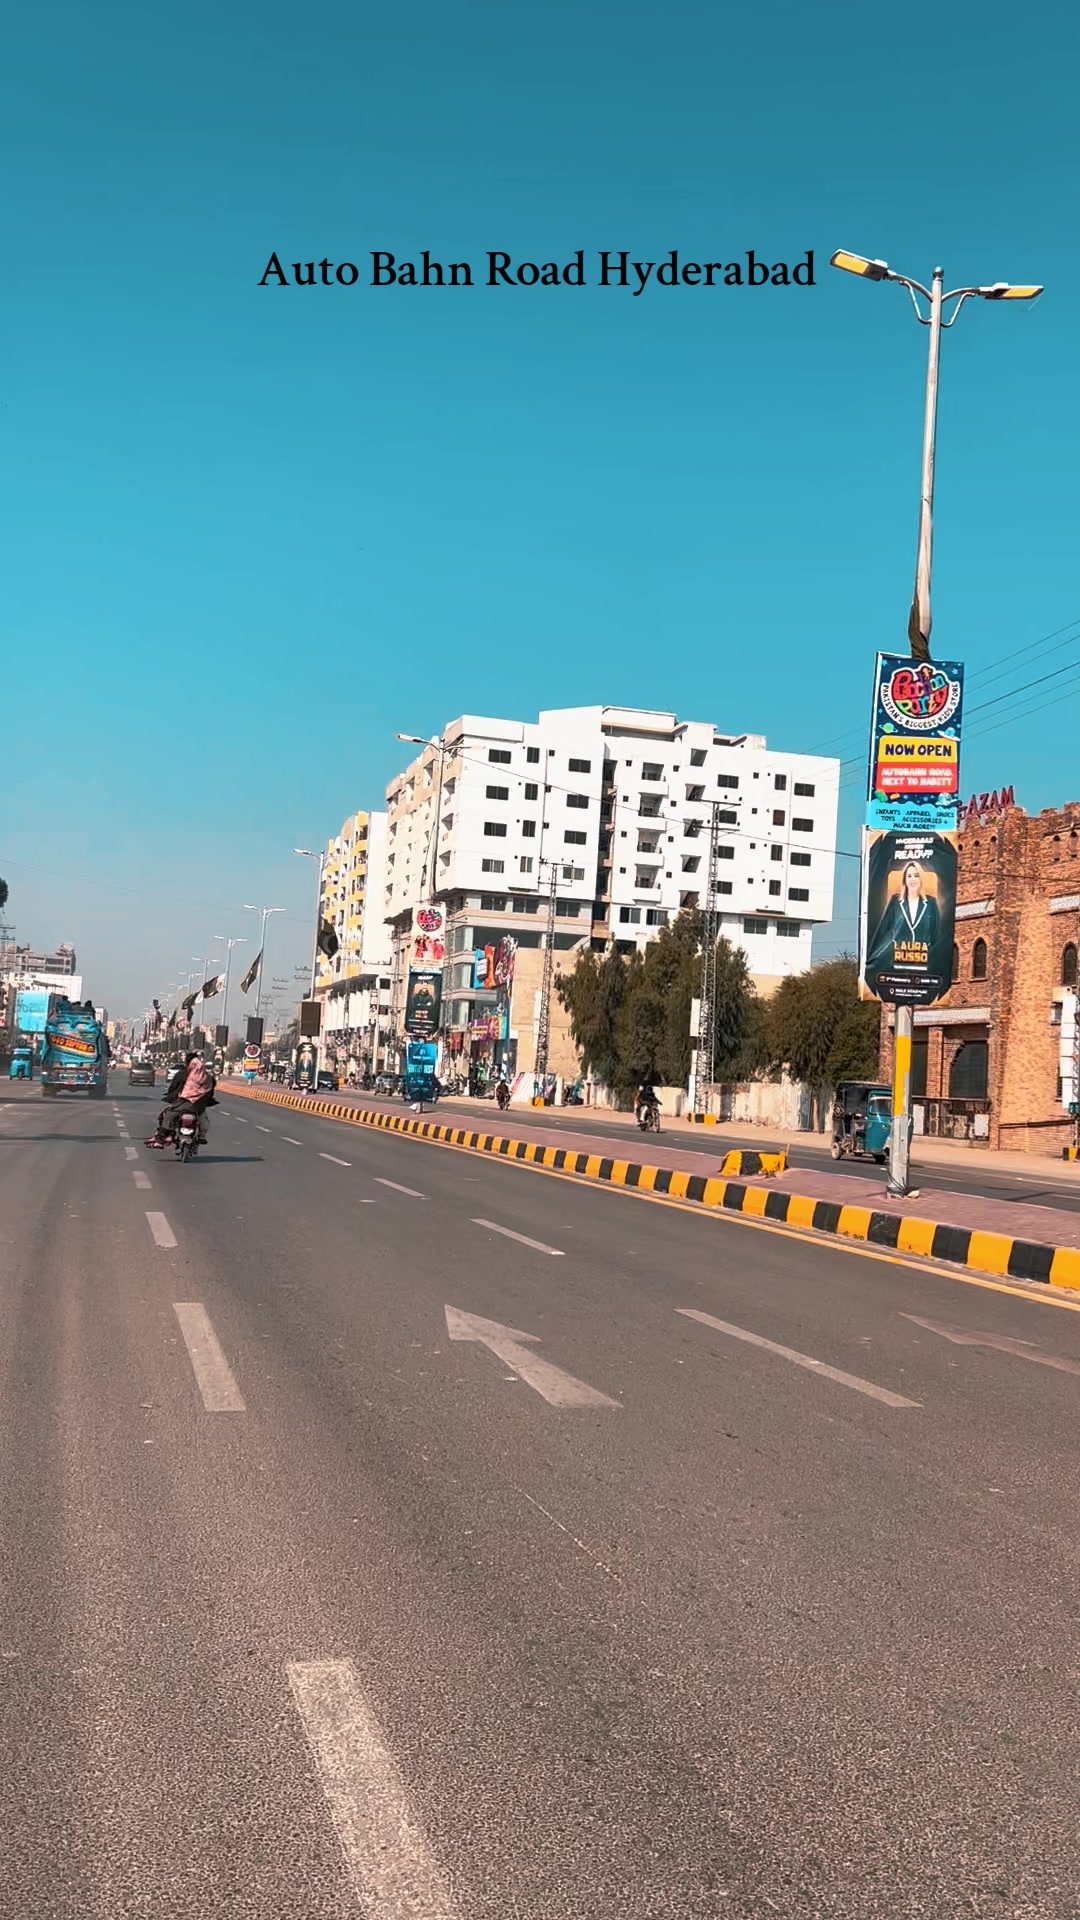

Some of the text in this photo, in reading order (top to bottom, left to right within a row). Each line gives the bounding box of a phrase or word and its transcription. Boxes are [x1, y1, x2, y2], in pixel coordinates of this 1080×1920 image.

[904, 719, 937, 729] BIGGEST
[937, 708, 954, 723] KIDS
[950, 683, 960, 707] STORE
[885, 743, 952, 757] NOW OPEN
[881, 777, 906, 786] NEXT
[907, 777, 919, 786] TO
[958, 785, 1015, 821] AZAM
[880, 815, 896, 823] TOYS
[894, 849, 934, 860] READY?
[893, 941, 929, 951] LAURA
[894, 951, 928, 962] RUSSO
